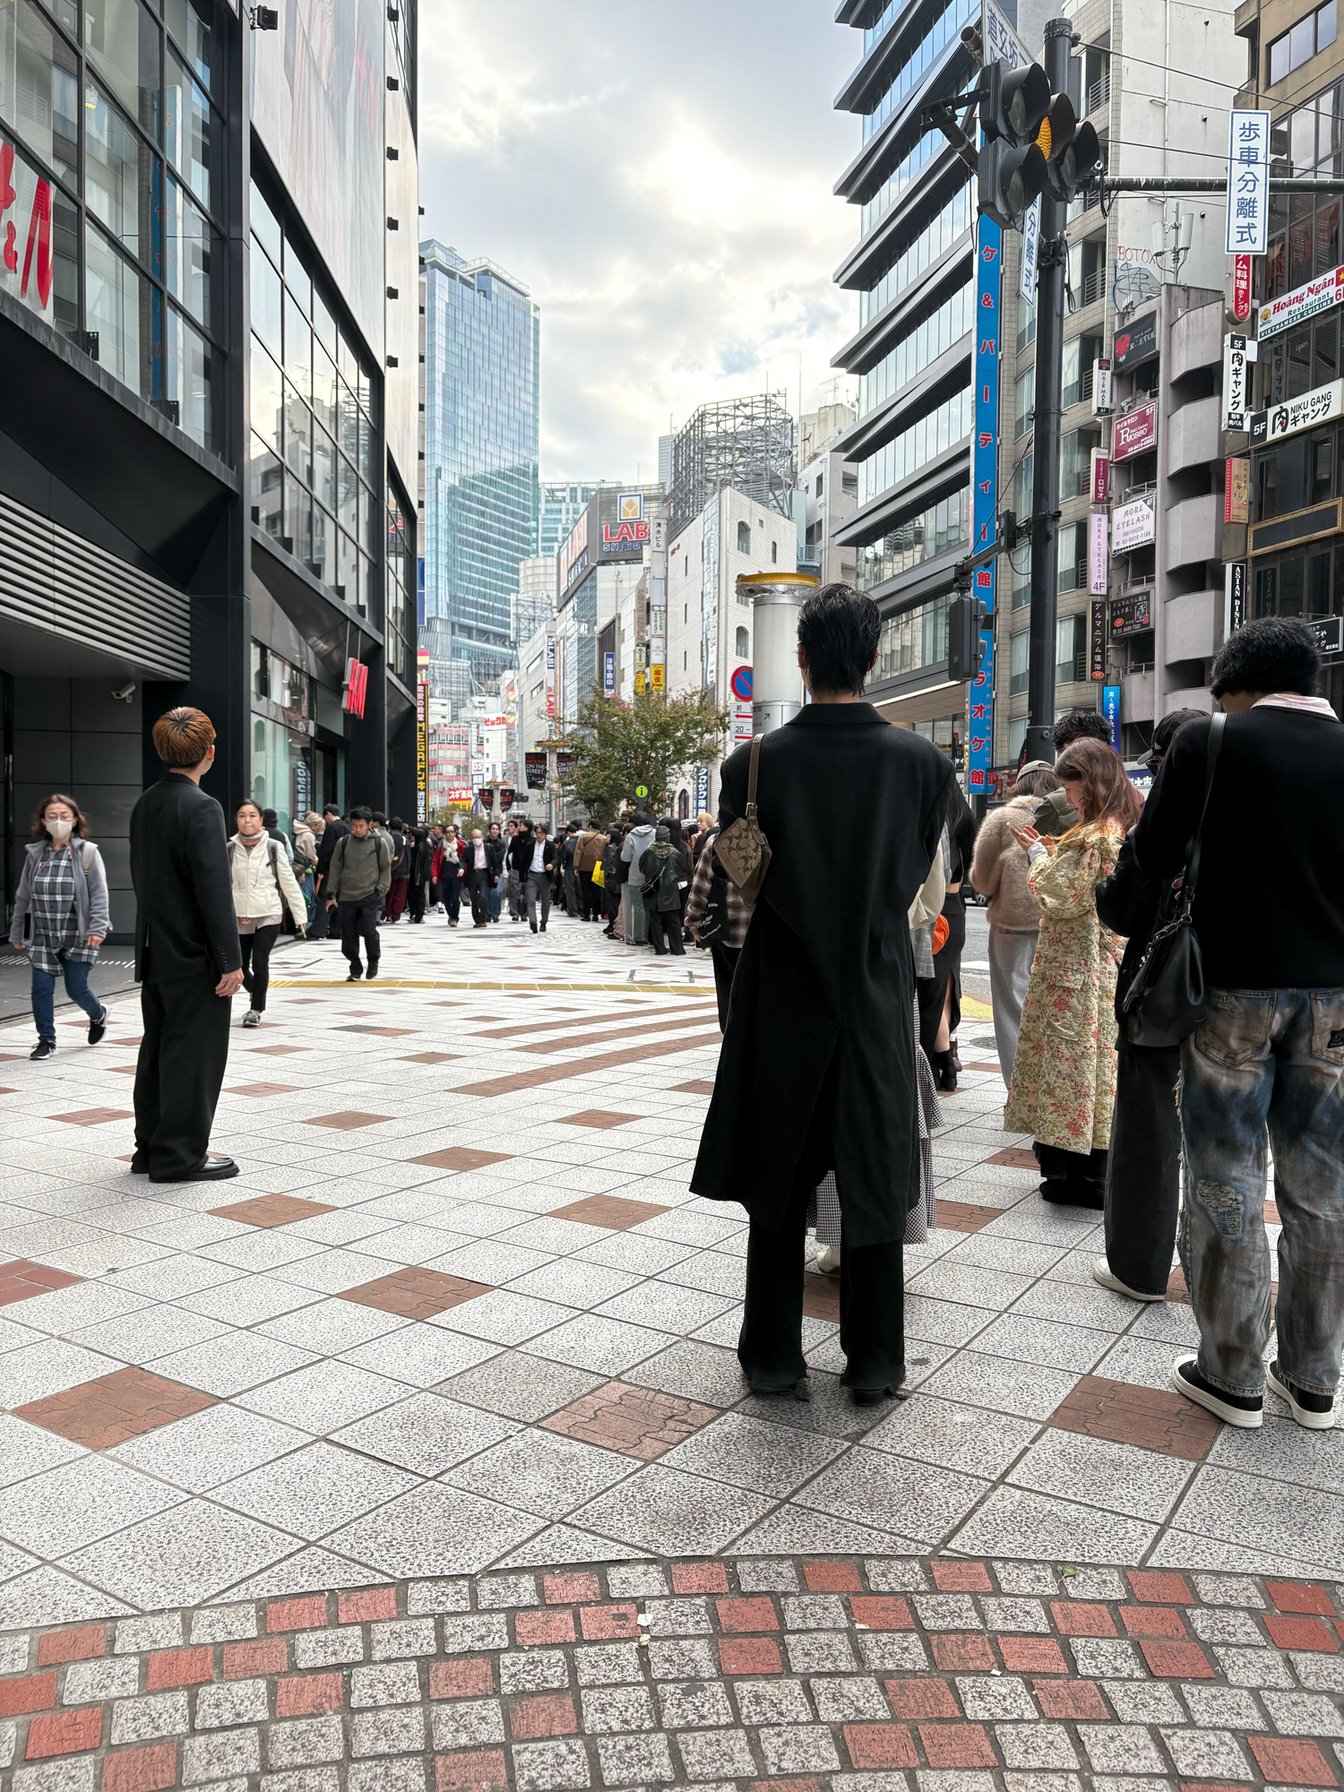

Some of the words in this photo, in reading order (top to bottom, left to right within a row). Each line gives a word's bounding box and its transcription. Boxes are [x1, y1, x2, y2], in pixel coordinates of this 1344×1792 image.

[1236, 121, 1261, 245] 歩車分離式
[1117, 246, 1157, 265] BOTOX
[1287, 291, 1330, 317] Restaurant
[1261, 313, 1302, 337] VIETNAMESE
[1303, 298, 1332, 317] CUISINE
[1234, 340, 1243, 349] 5F
[1231, 351, 1244, 411] 肉ギャング
[1145, 407, 1154, 417] 5F
[1290, 402, 1309, 415] NIKU
[1310, 391, 1332, 408] GANG
[1290, 401, 1332, 427] ギャング
[1253, 421, 1266, 436] 5F
[1123, 504, 1144, 518] MORE
[1116, 512, 1151, 531] EYELASH
[1093, 581, 1106, 592] 4F
